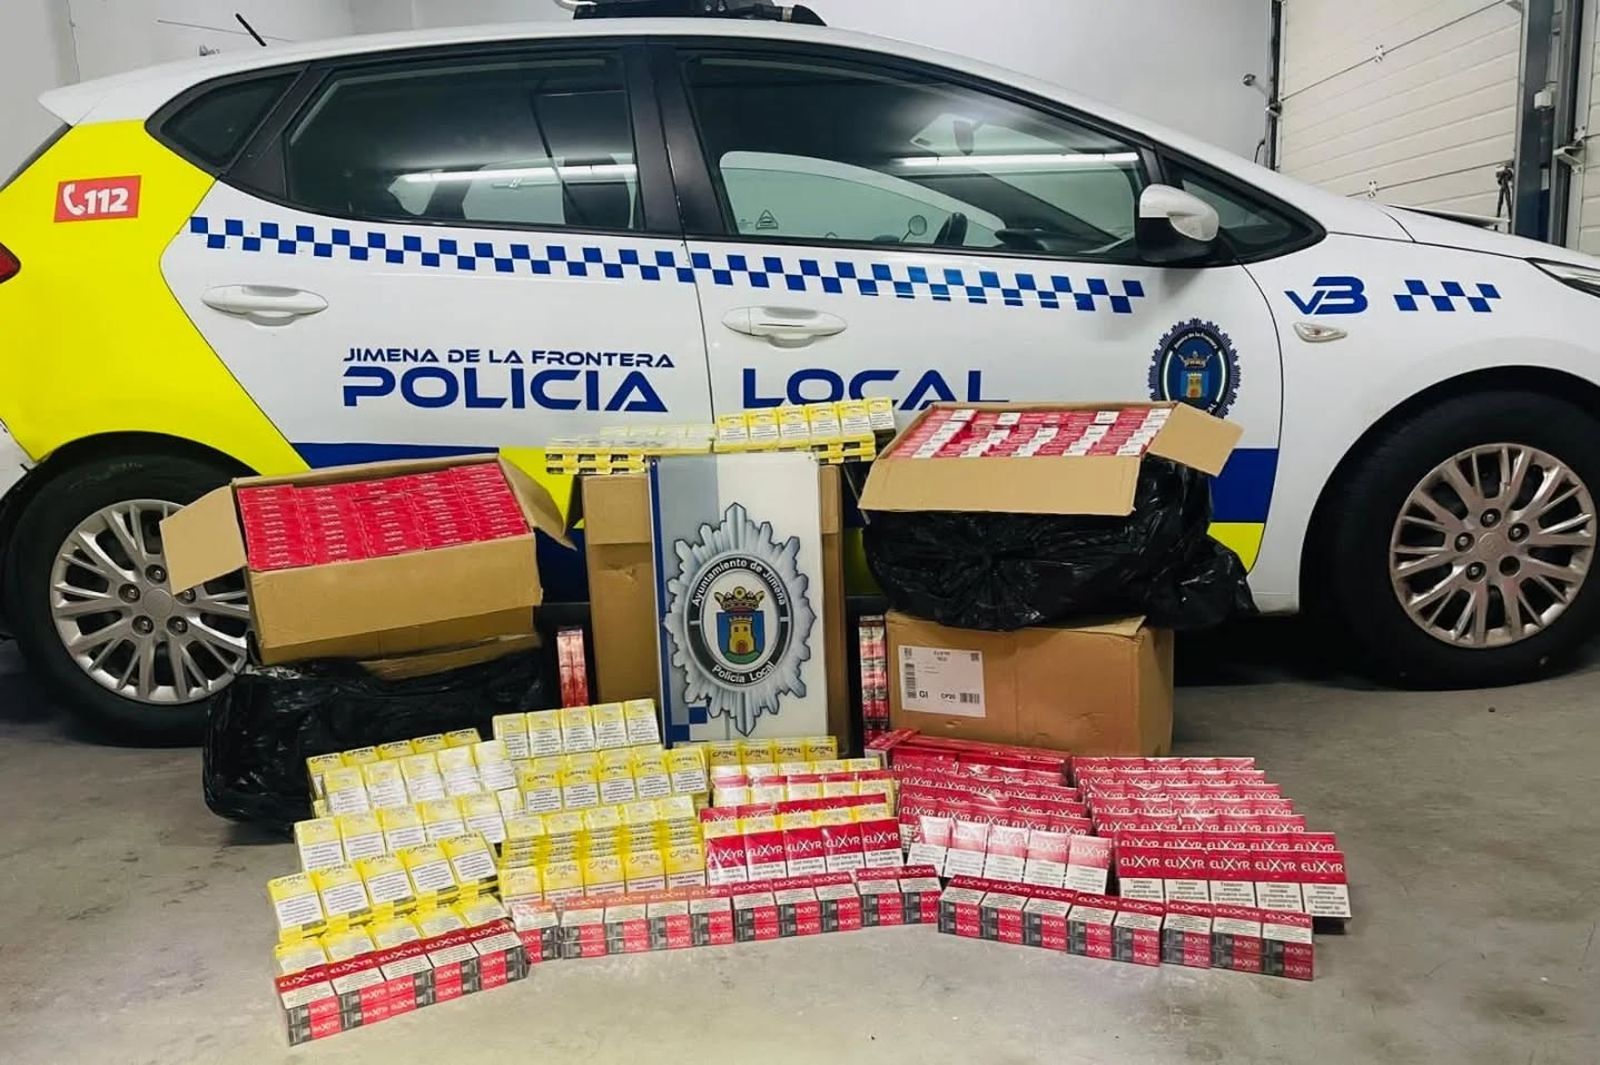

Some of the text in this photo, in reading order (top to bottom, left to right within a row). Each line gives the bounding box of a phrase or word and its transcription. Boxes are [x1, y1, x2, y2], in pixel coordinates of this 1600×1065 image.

[84, 187, 128, 214] 112
[343, 348, 675, 368] JIMENA DE LA FRONTERA
[343, 365, 668, 412] POLICIA
[743, 368, 1010, 410] LOCAL
[692, 559, 785, 606] Ayuntamiento de Jimena
[749, 661, 775, 681] Local
[787, 837, 822, 853] ELIXYR
[826, 833, 860, 849] ELIXYR
[864, 829, 898, 845] ELIXYR
[1120, 857, 1344, 874] ELIXYR ELIXYR ELIXYR ELIXYR ELIXYR
